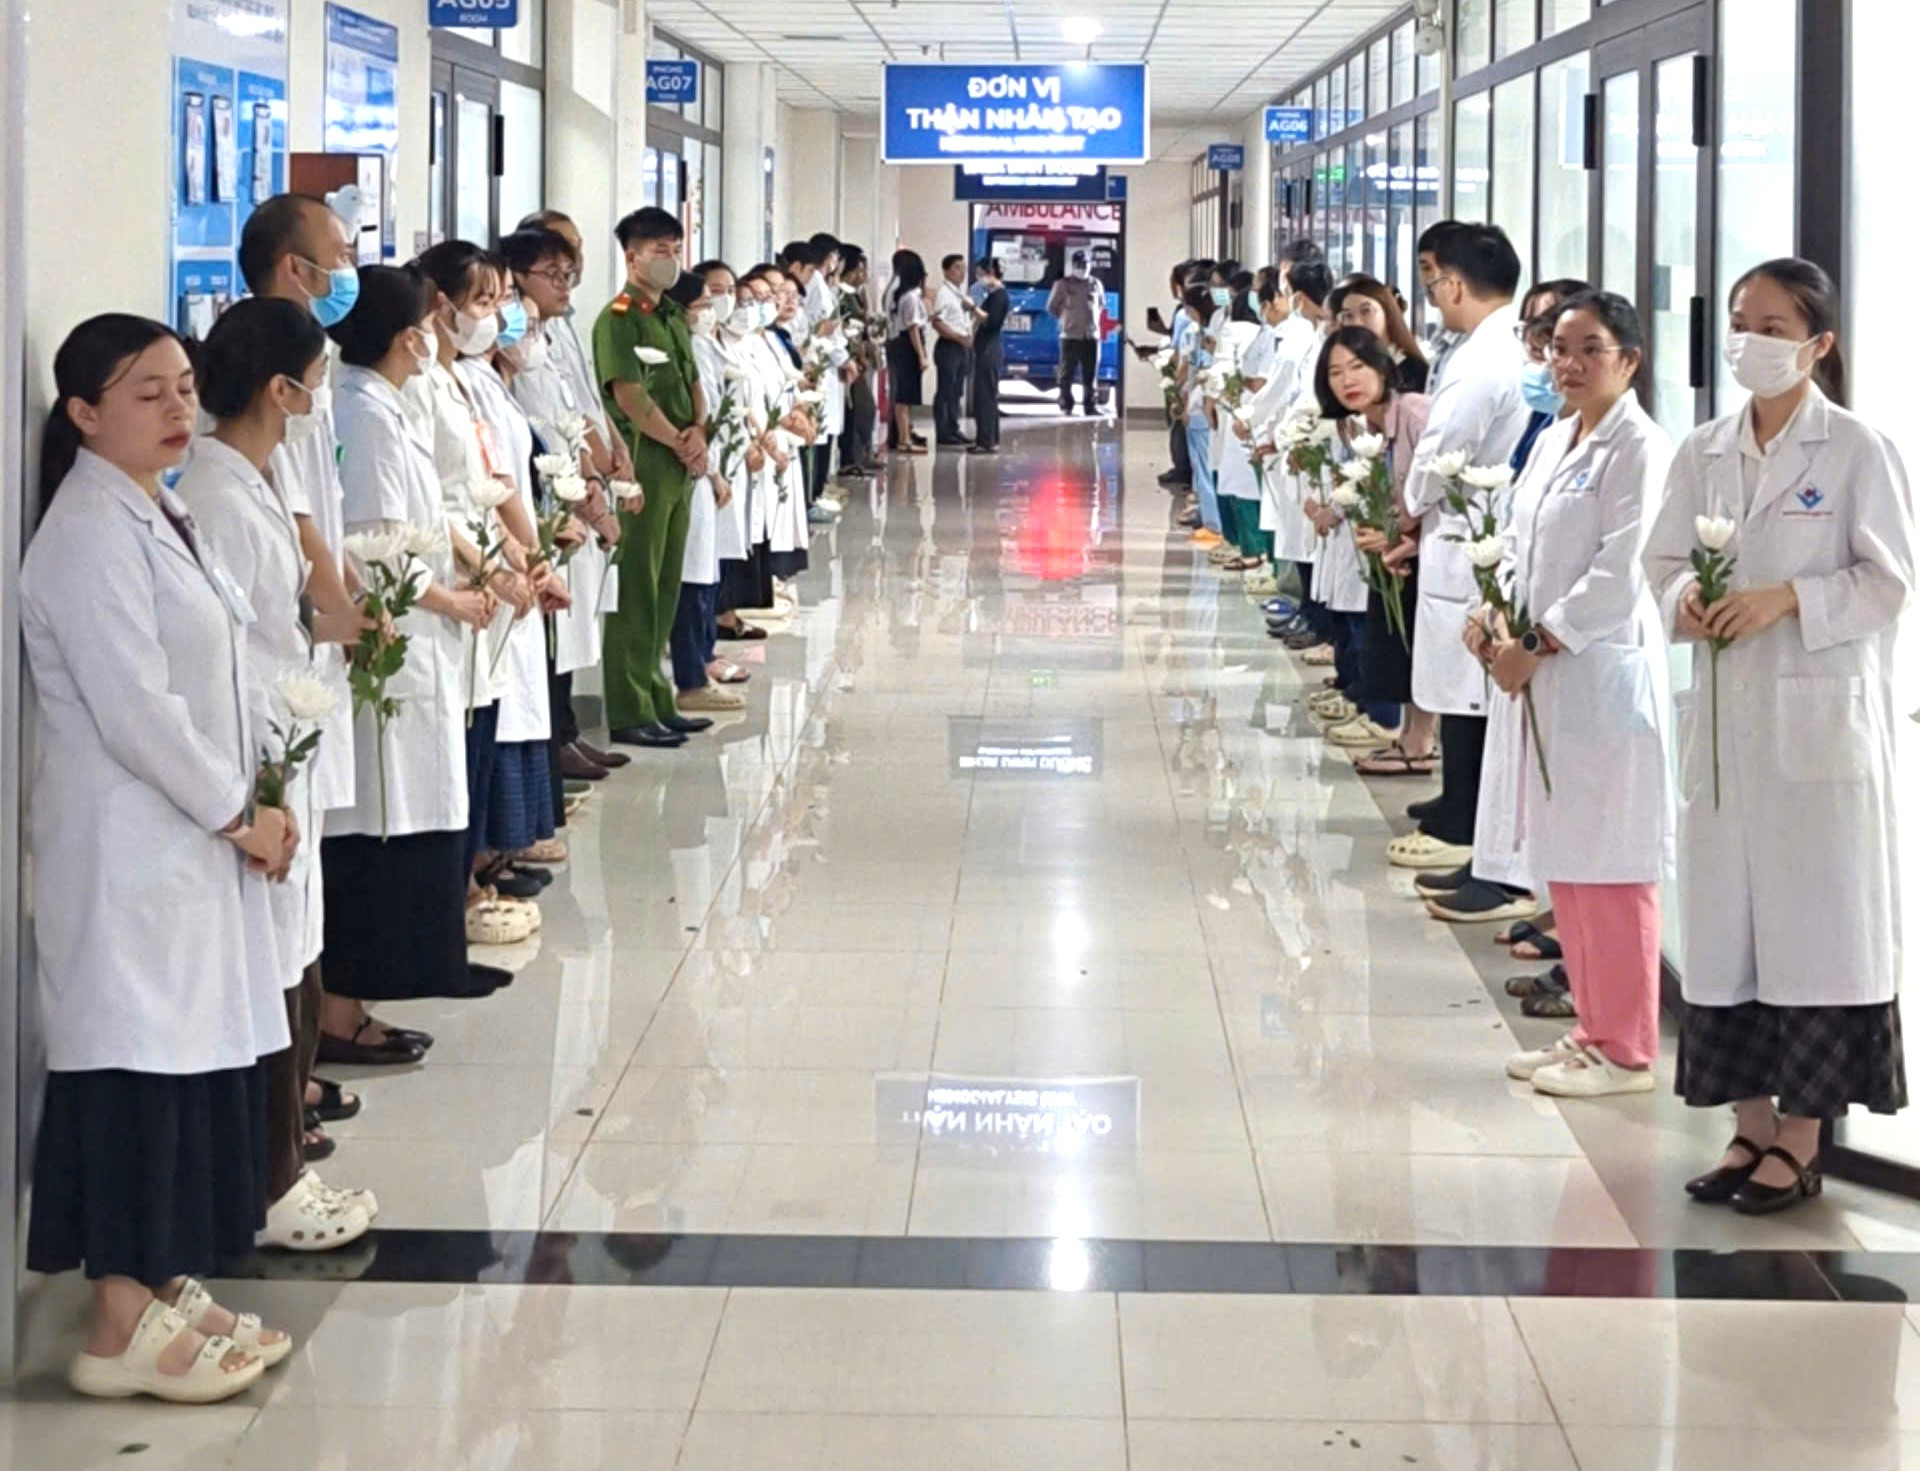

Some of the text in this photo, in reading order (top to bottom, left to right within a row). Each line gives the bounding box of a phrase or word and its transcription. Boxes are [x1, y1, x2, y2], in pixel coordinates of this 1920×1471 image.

[646, 75, 693, 91] AG07
[967, 74, 1060, 102] ĐƠN VỊ
[906, 102, 980, 135] THẬN
[1068, 106, 1122, 135] TẠO
[1268, 119, 1308, 132] AG06
